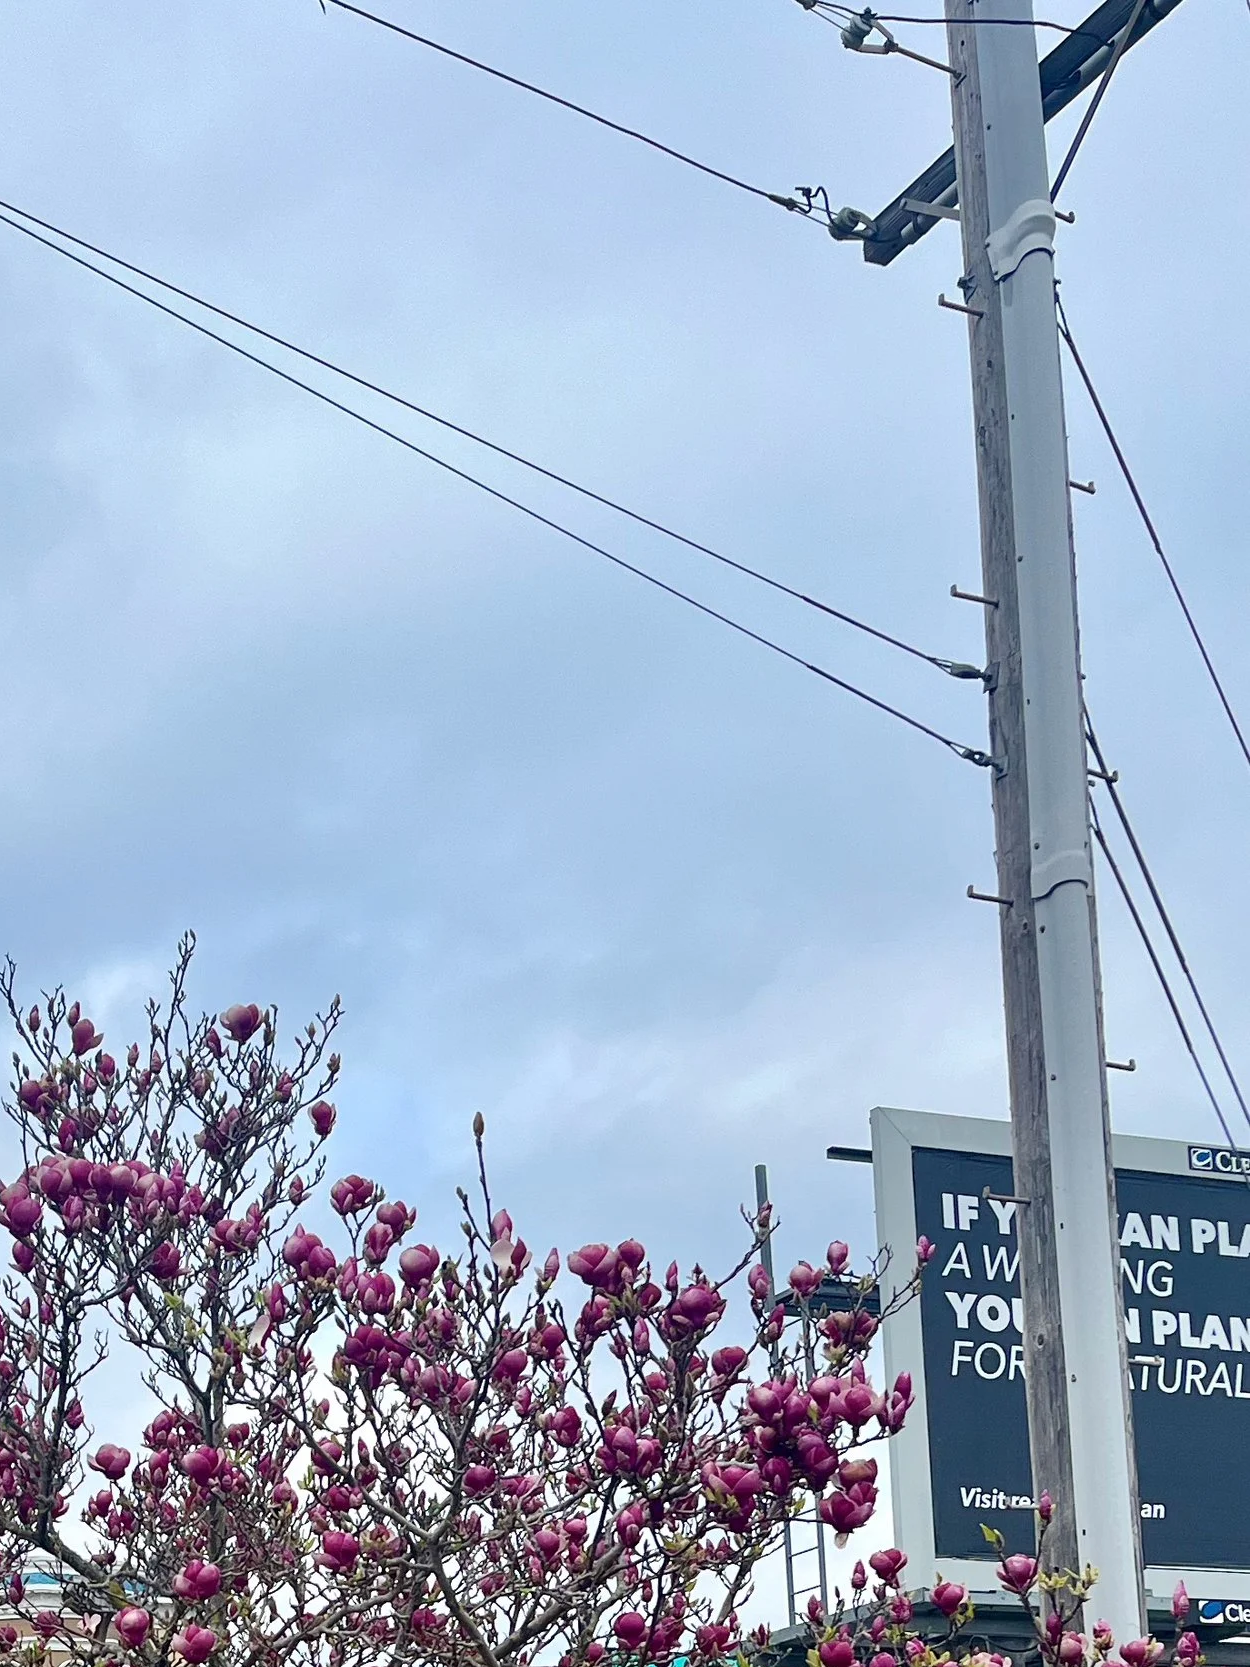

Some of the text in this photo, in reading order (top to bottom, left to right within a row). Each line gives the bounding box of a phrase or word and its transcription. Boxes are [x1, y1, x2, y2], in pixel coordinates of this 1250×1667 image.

[941, 1192, 980, 1231] IF
[1117, 1211, 1181, 1252] AN
[941, 1242, 972, 1279] A
[960, 1486, 1007, 1510] Visit
